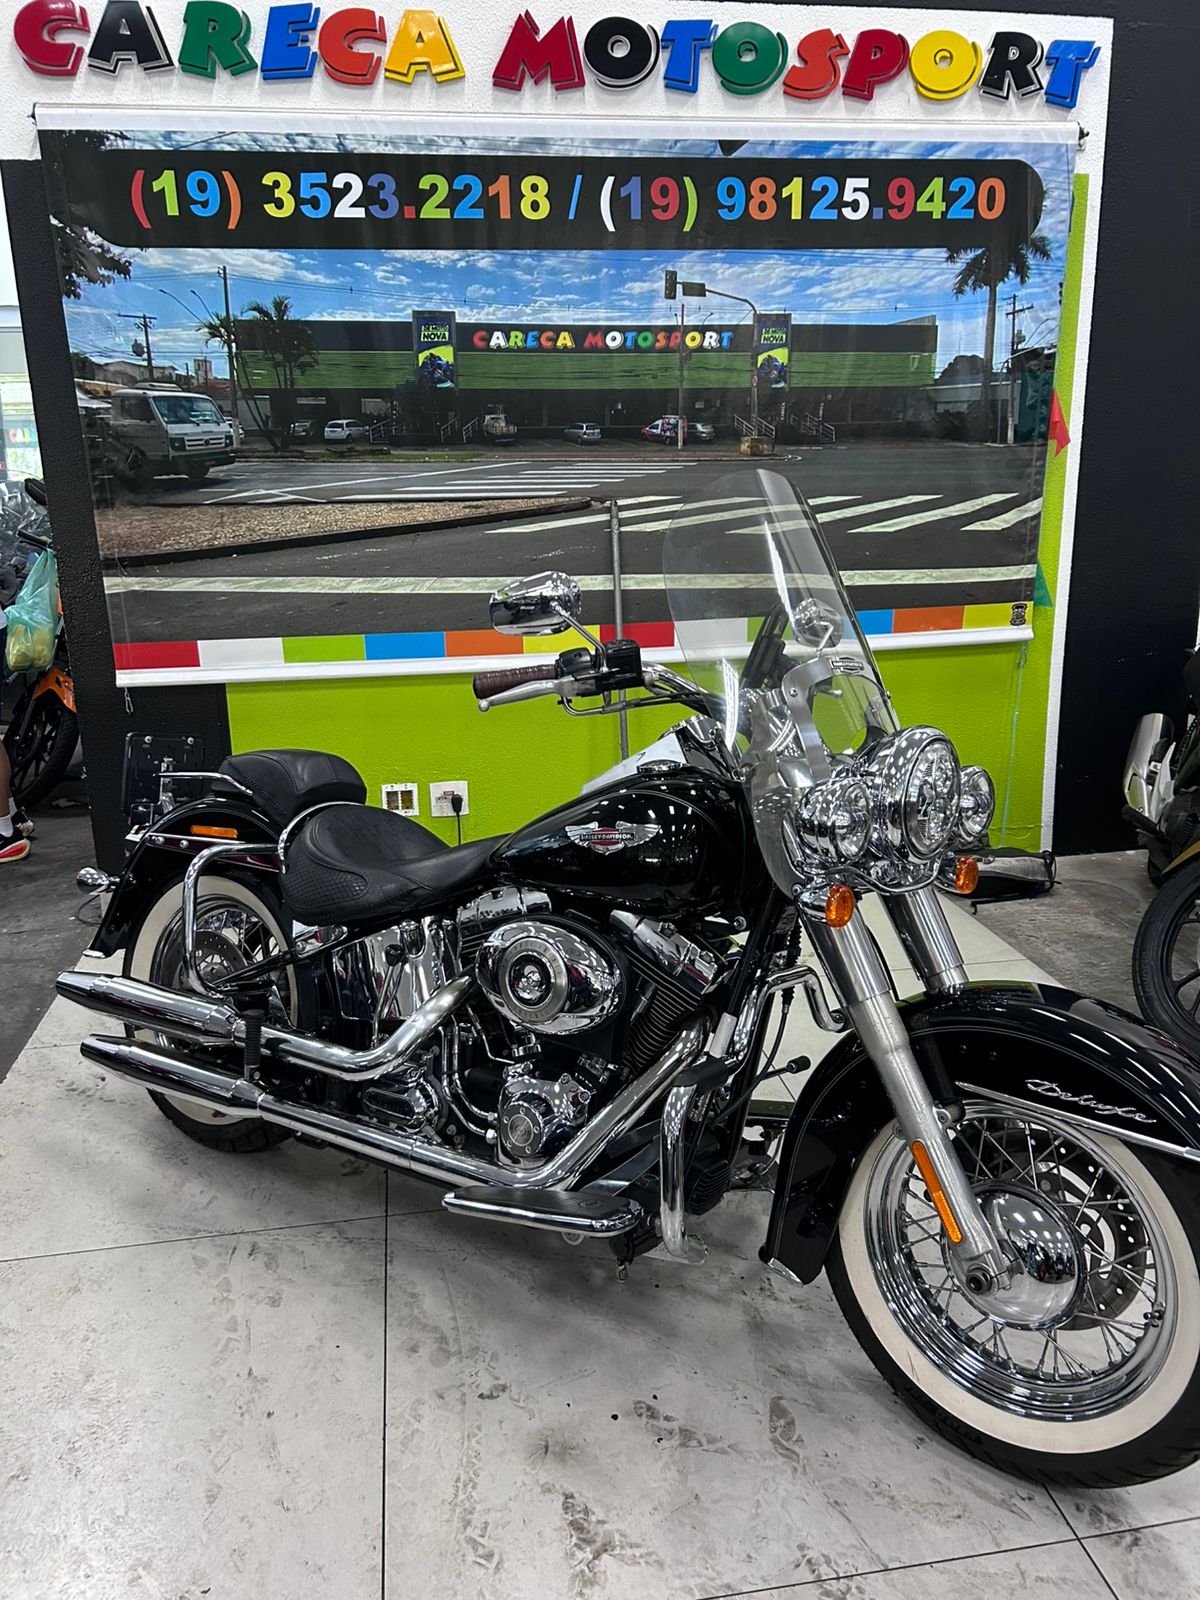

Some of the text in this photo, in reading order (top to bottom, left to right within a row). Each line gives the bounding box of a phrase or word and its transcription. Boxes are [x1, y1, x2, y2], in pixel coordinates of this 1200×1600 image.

[14, 0, 1101, 108] CARECA MOTOSPORT
[131, 169, 1006, 232] (19) 3523.2218 / (19) 98125.9420
[422, 332, 448, 341] NOVA
[473, 330, 734, 350] CARECA MOTOSPORT
[762, 335, 785, 343] NOVA
[1025, 1079, 1157, 1123] Deluxe
